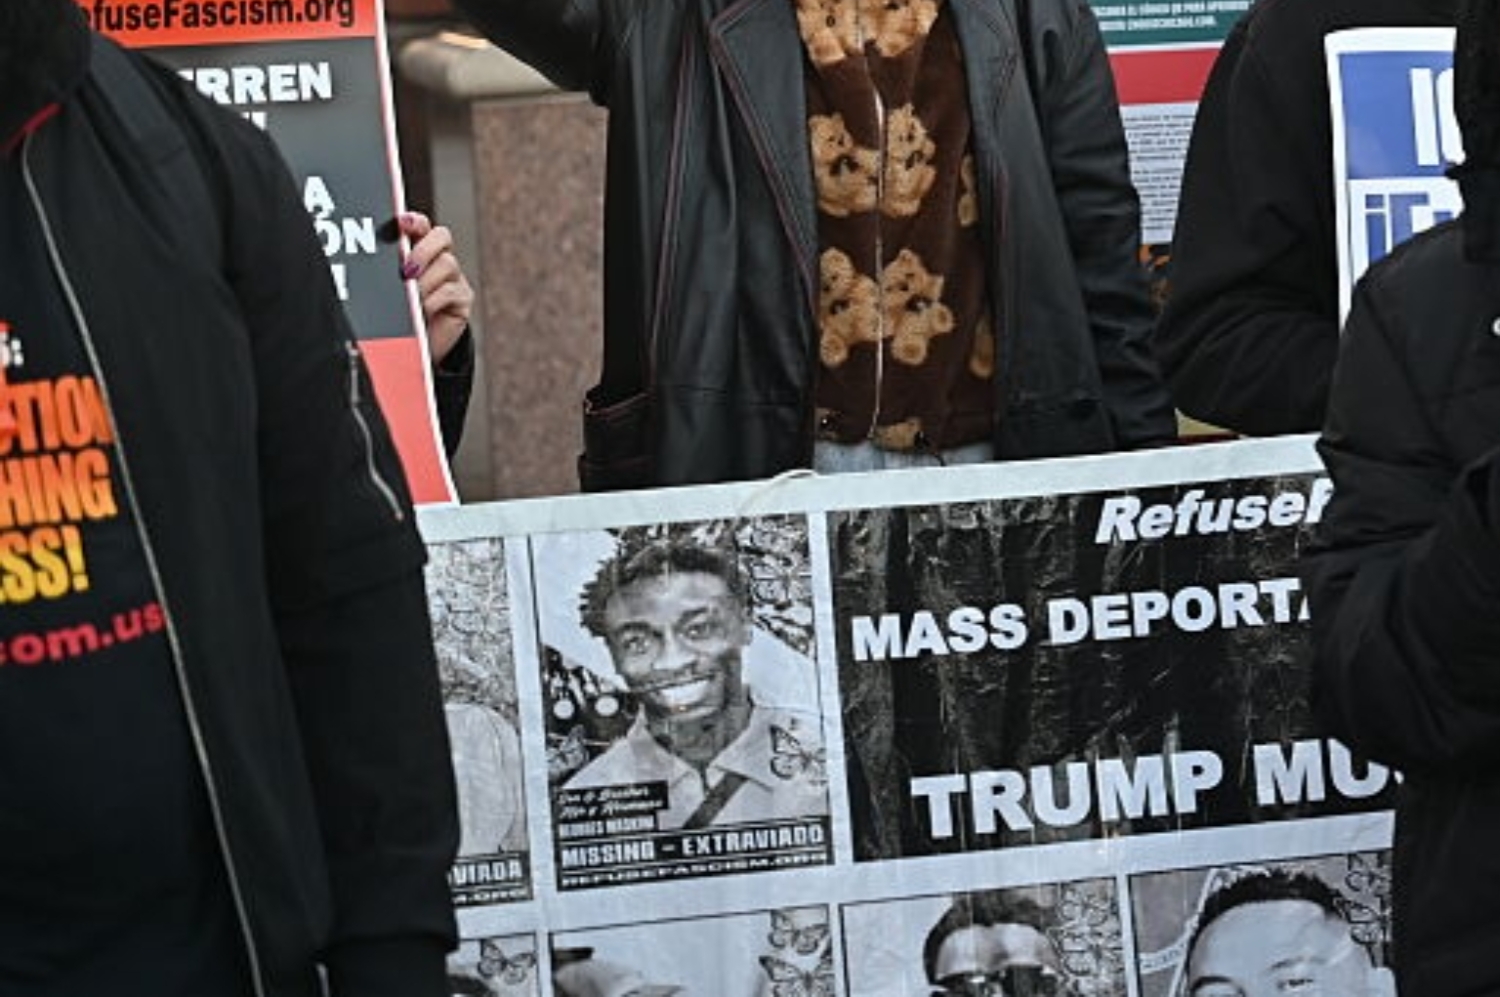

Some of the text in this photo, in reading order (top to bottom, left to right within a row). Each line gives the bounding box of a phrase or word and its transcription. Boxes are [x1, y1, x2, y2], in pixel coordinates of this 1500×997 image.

[177, 62, 333, 105] RREN
[0, 522, 89, 604] SS!
[0, 602, 165, 665] om.us
[851, 577, 1311, 662] MASS DEPORT
[911, 738, 1405, 840] TRUMP MU
[562, 840, 655, 869] MISSING
[682, 823, 825, 857] EXTRAVIADO
